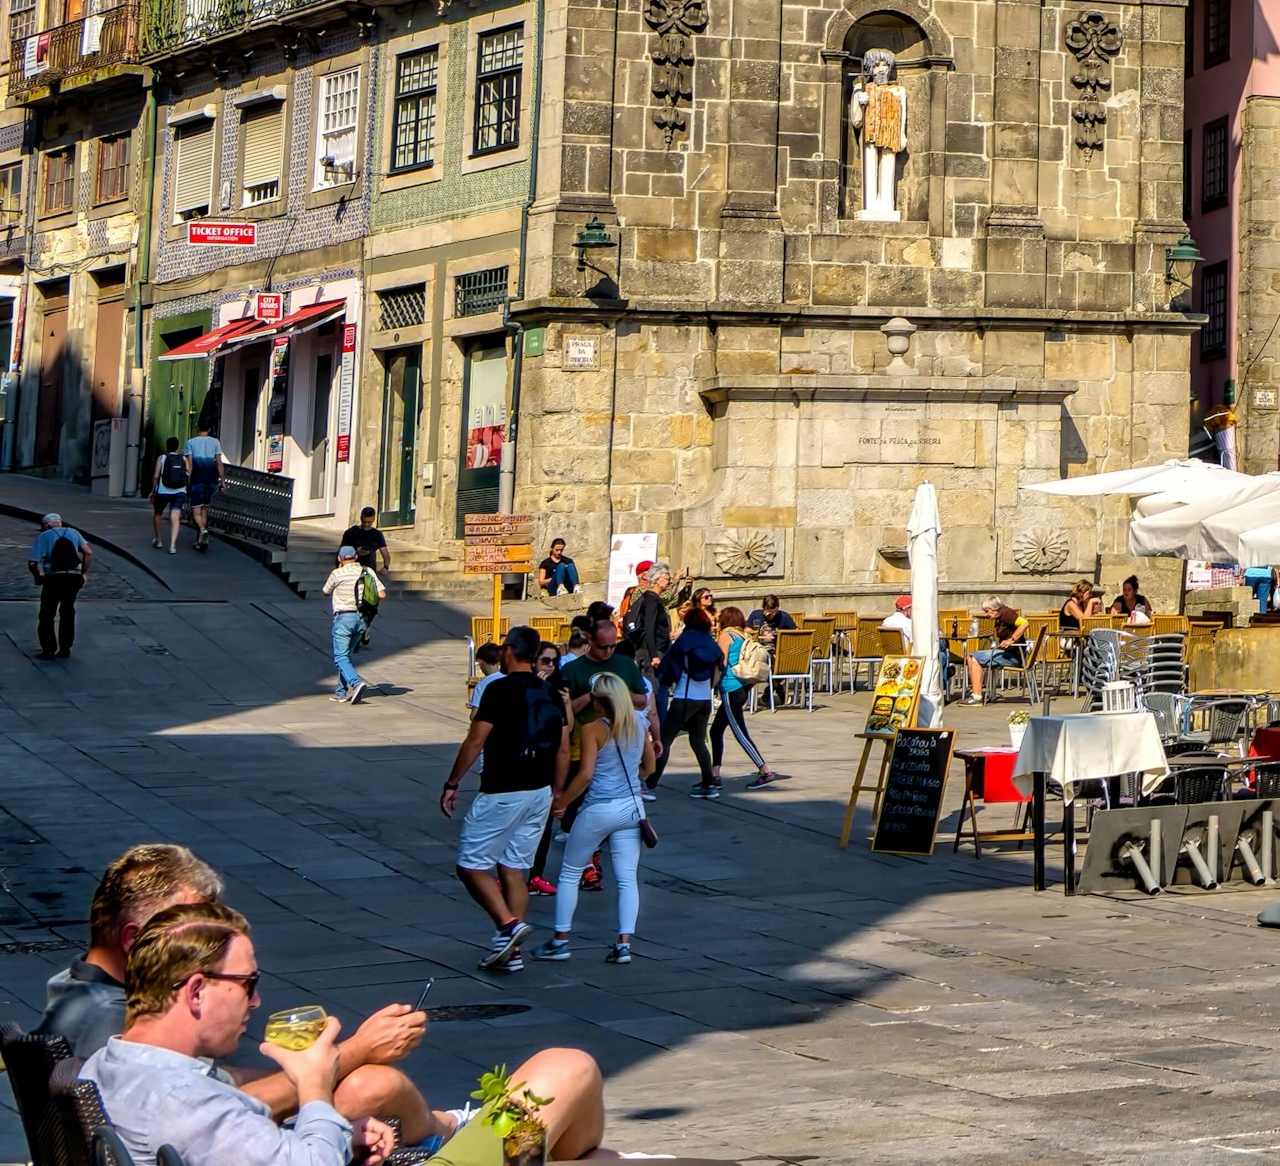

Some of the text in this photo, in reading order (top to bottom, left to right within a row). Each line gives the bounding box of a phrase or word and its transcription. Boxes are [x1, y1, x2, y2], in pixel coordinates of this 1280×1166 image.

[191, 227, 254, 237] TICKET OFFICE
[858, 437, 877, 445] FONTE
[919, 437, 942, 445] RIBEIRA
[468, 547, 510, 555] ALHEIRA
[466, 564, 513, 572] PETISCOS
